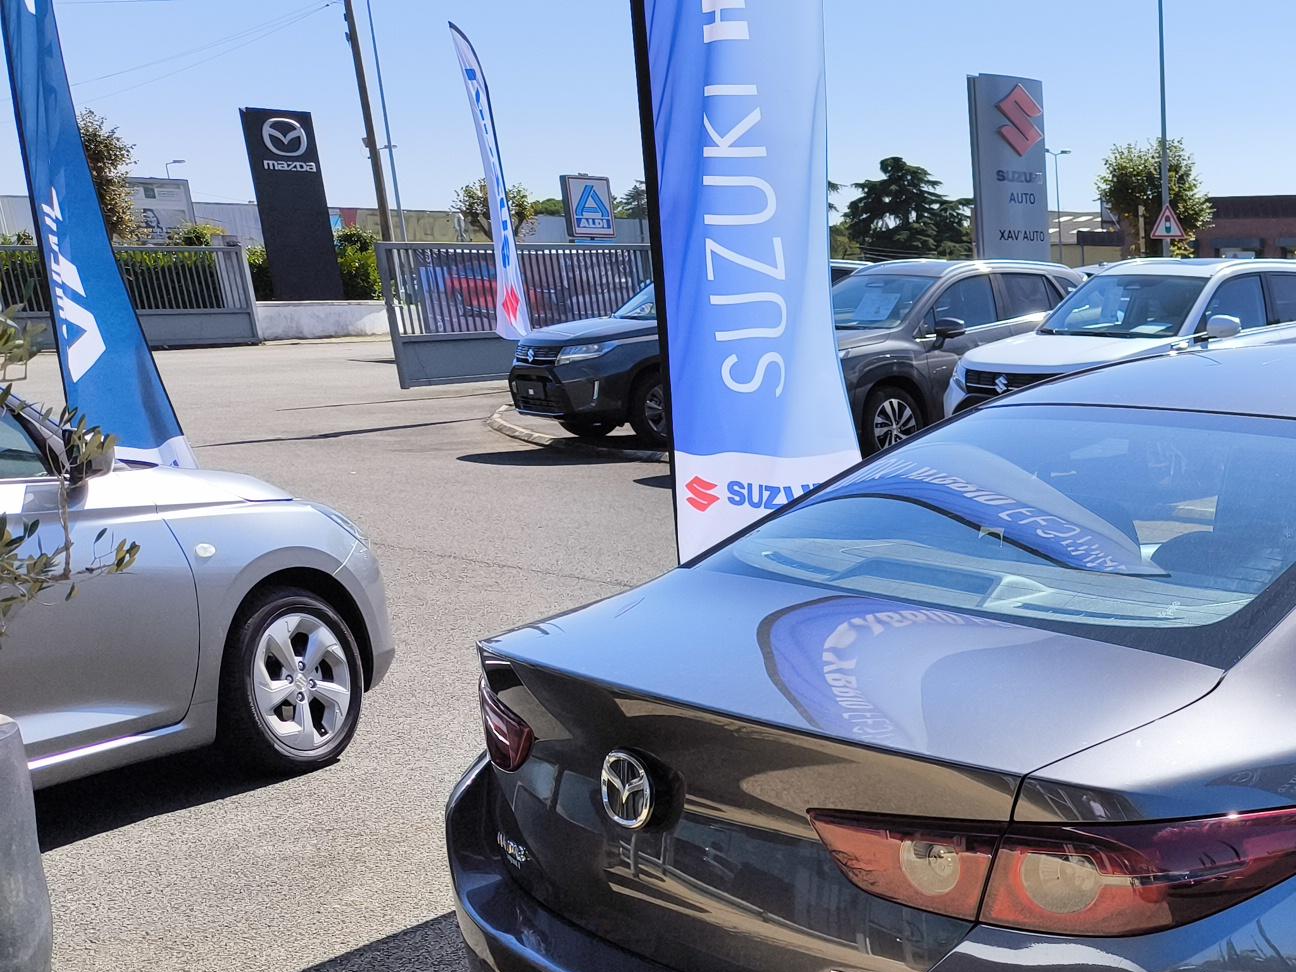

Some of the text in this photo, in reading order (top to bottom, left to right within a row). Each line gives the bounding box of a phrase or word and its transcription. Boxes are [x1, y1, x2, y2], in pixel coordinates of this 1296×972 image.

[1009, 193, 1036, 205] AUTO
[580, 218, 608, 228] ALDI
[703, 84, 787, 398] SUZUKI
